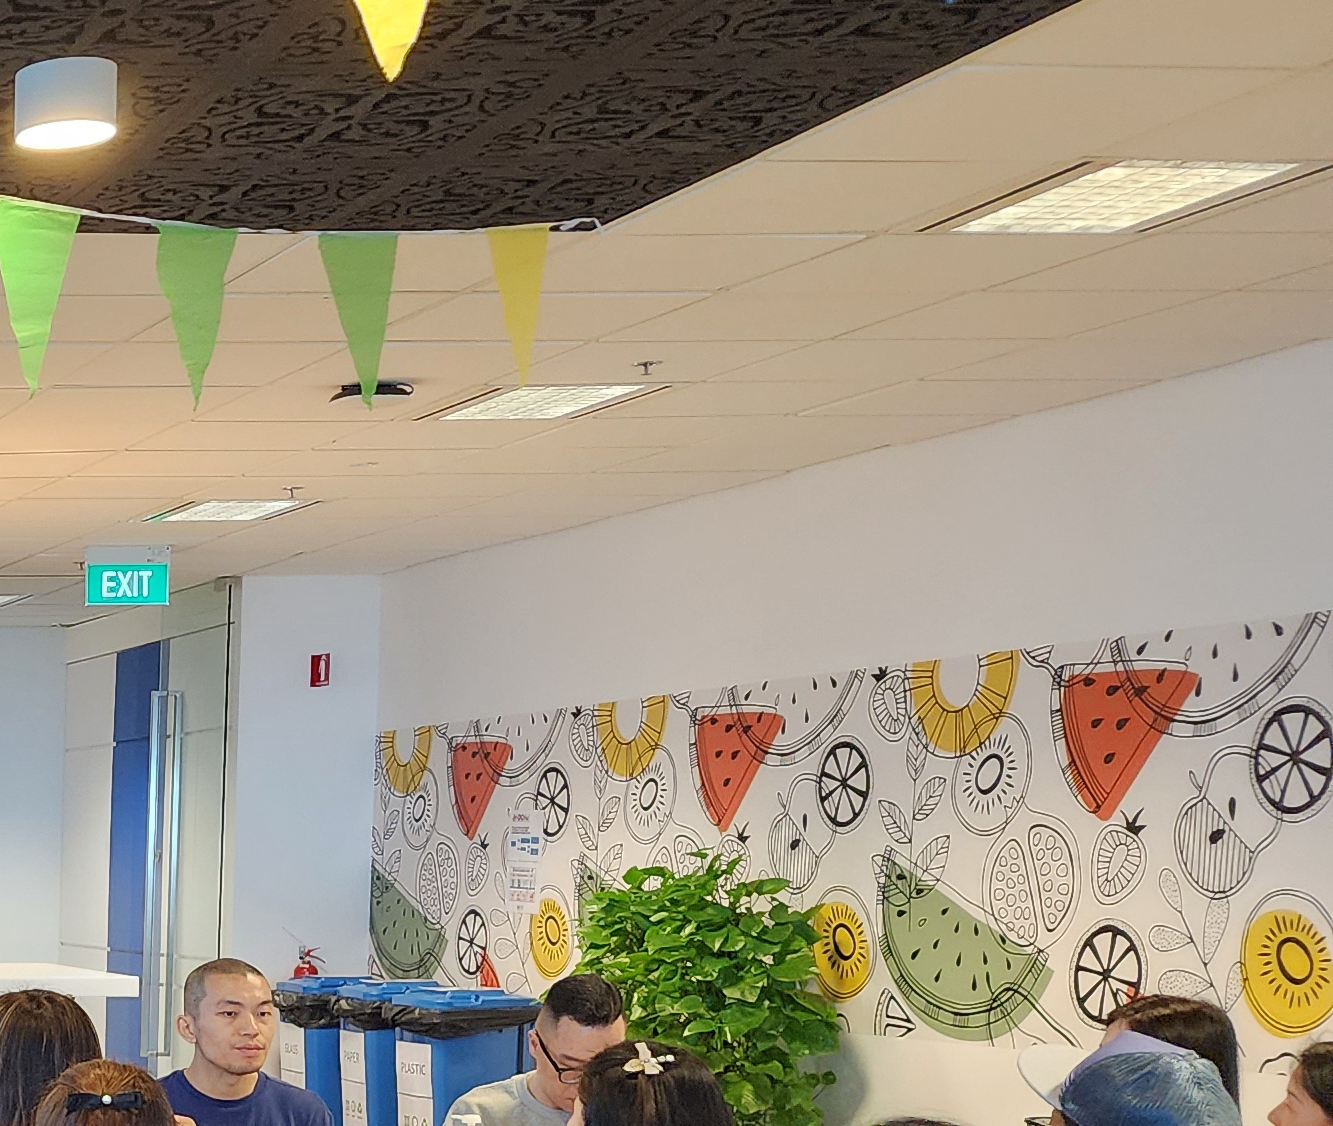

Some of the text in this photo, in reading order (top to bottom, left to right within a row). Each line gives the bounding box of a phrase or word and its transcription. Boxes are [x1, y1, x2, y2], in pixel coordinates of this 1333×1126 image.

[101, 570, 153, 598] EXIT
[285, 1043, 299, 1054] GLASS
[343, 1050, 360, 1064] PAPER
[401, 1062, 426, 1076] PLASTIC
